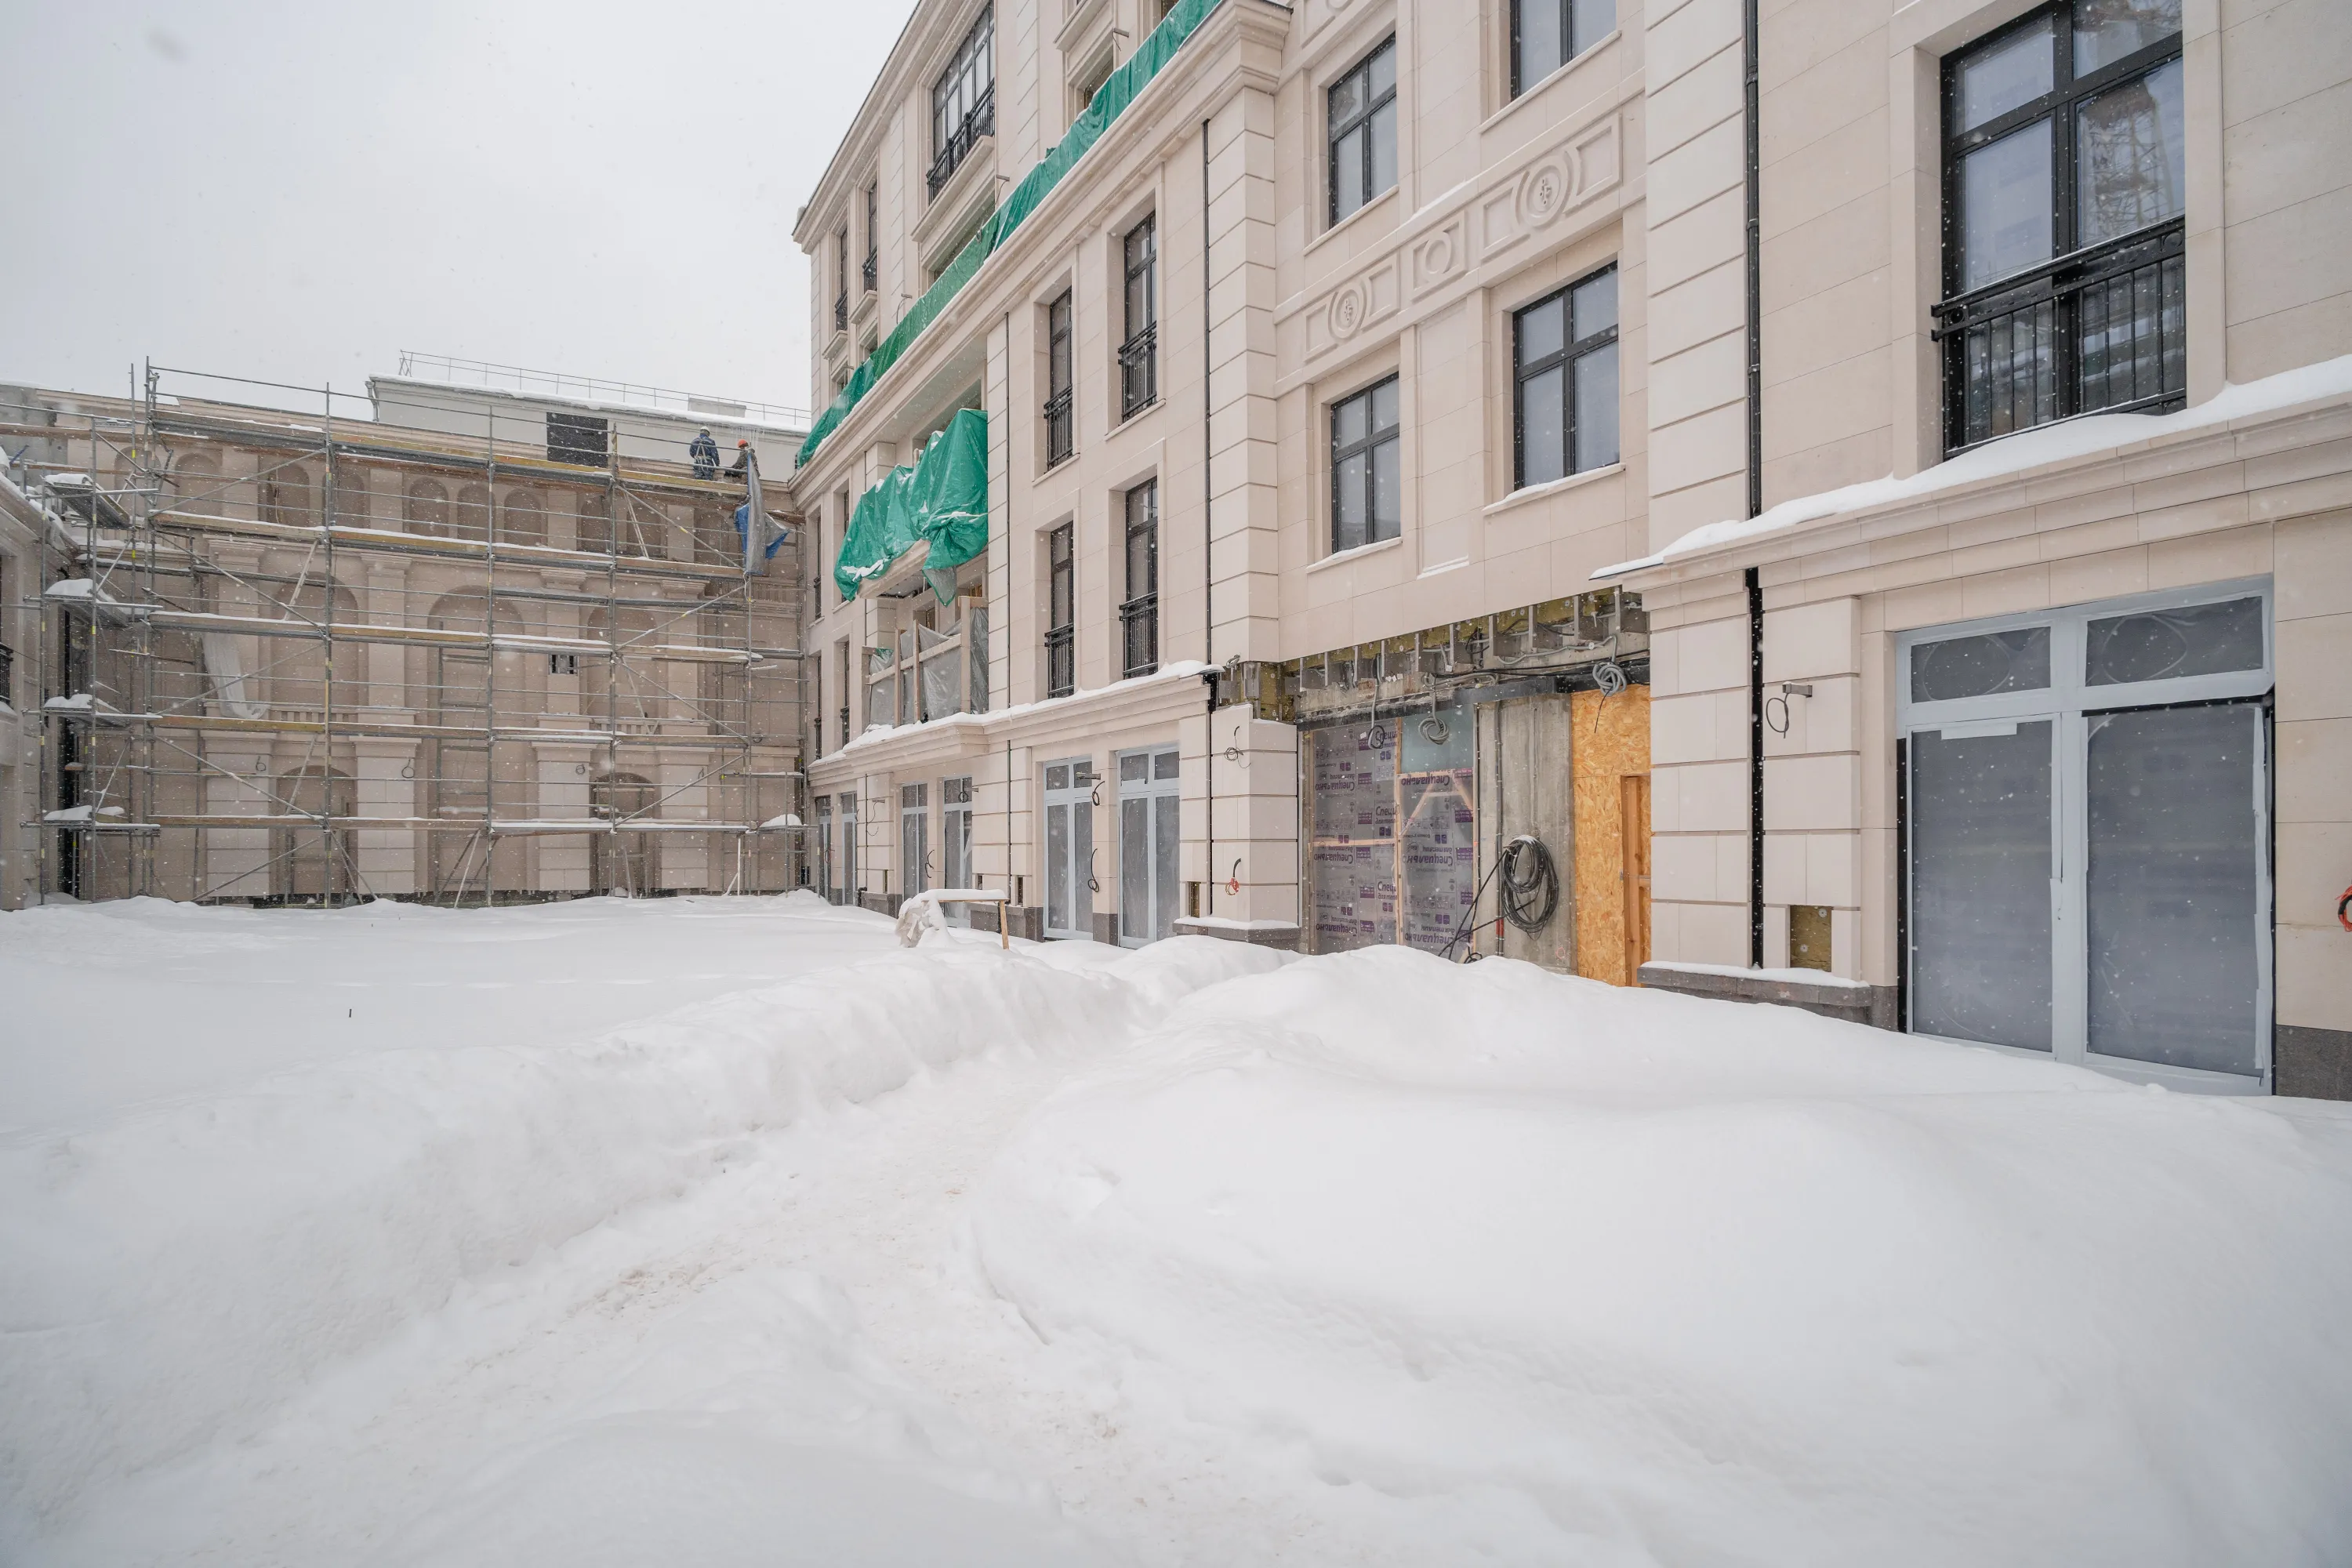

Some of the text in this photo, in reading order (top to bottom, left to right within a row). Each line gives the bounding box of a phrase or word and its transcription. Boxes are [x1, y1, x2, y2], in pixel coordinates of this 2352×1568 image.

[1315, 781, 1356, 791] Специально
[1314, 852, 1354, 864] Специально
[1316, 924, 1357, 936] Специально
